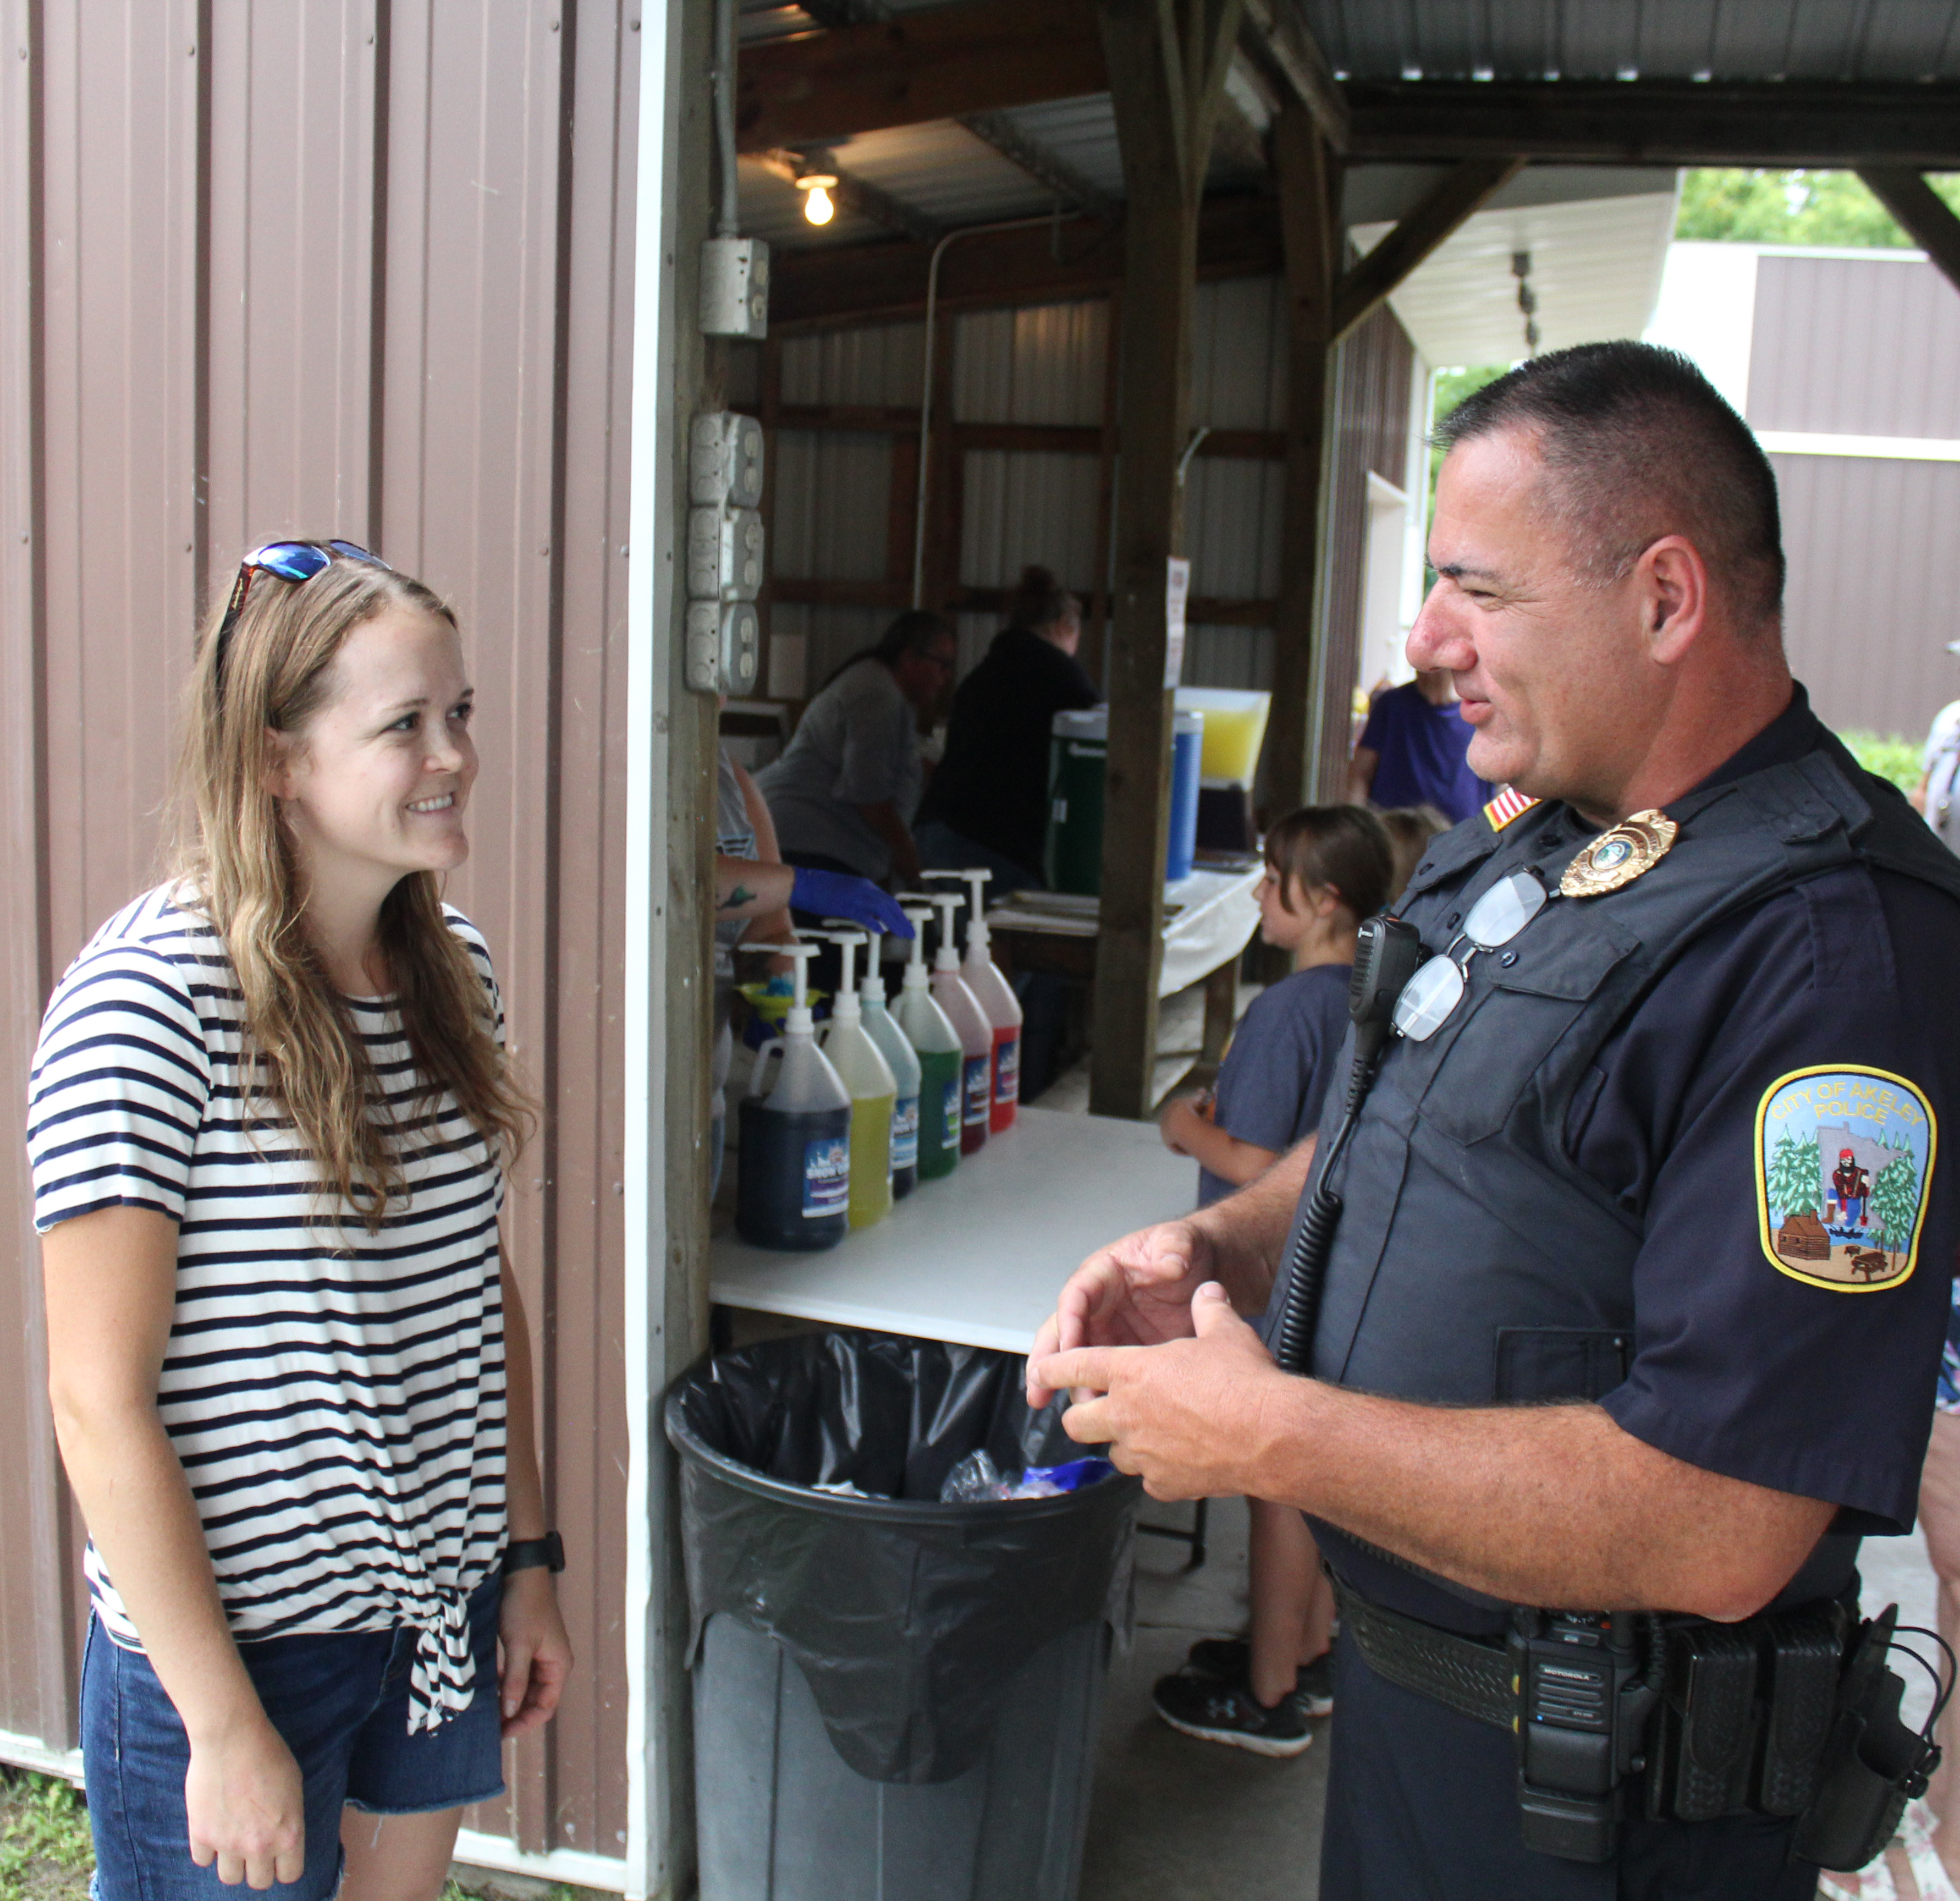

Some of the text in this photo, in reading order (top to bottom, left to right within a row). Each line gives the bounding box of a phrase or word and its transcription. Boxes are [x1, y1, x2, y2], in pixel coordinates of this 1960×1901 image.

[1770, 1081, 1925, 1125] CITY OF AKELEY
[1814, 1100, 1890, 1126] POLICE
[1544, 1668, 1589, 1680] MOTOROLA
